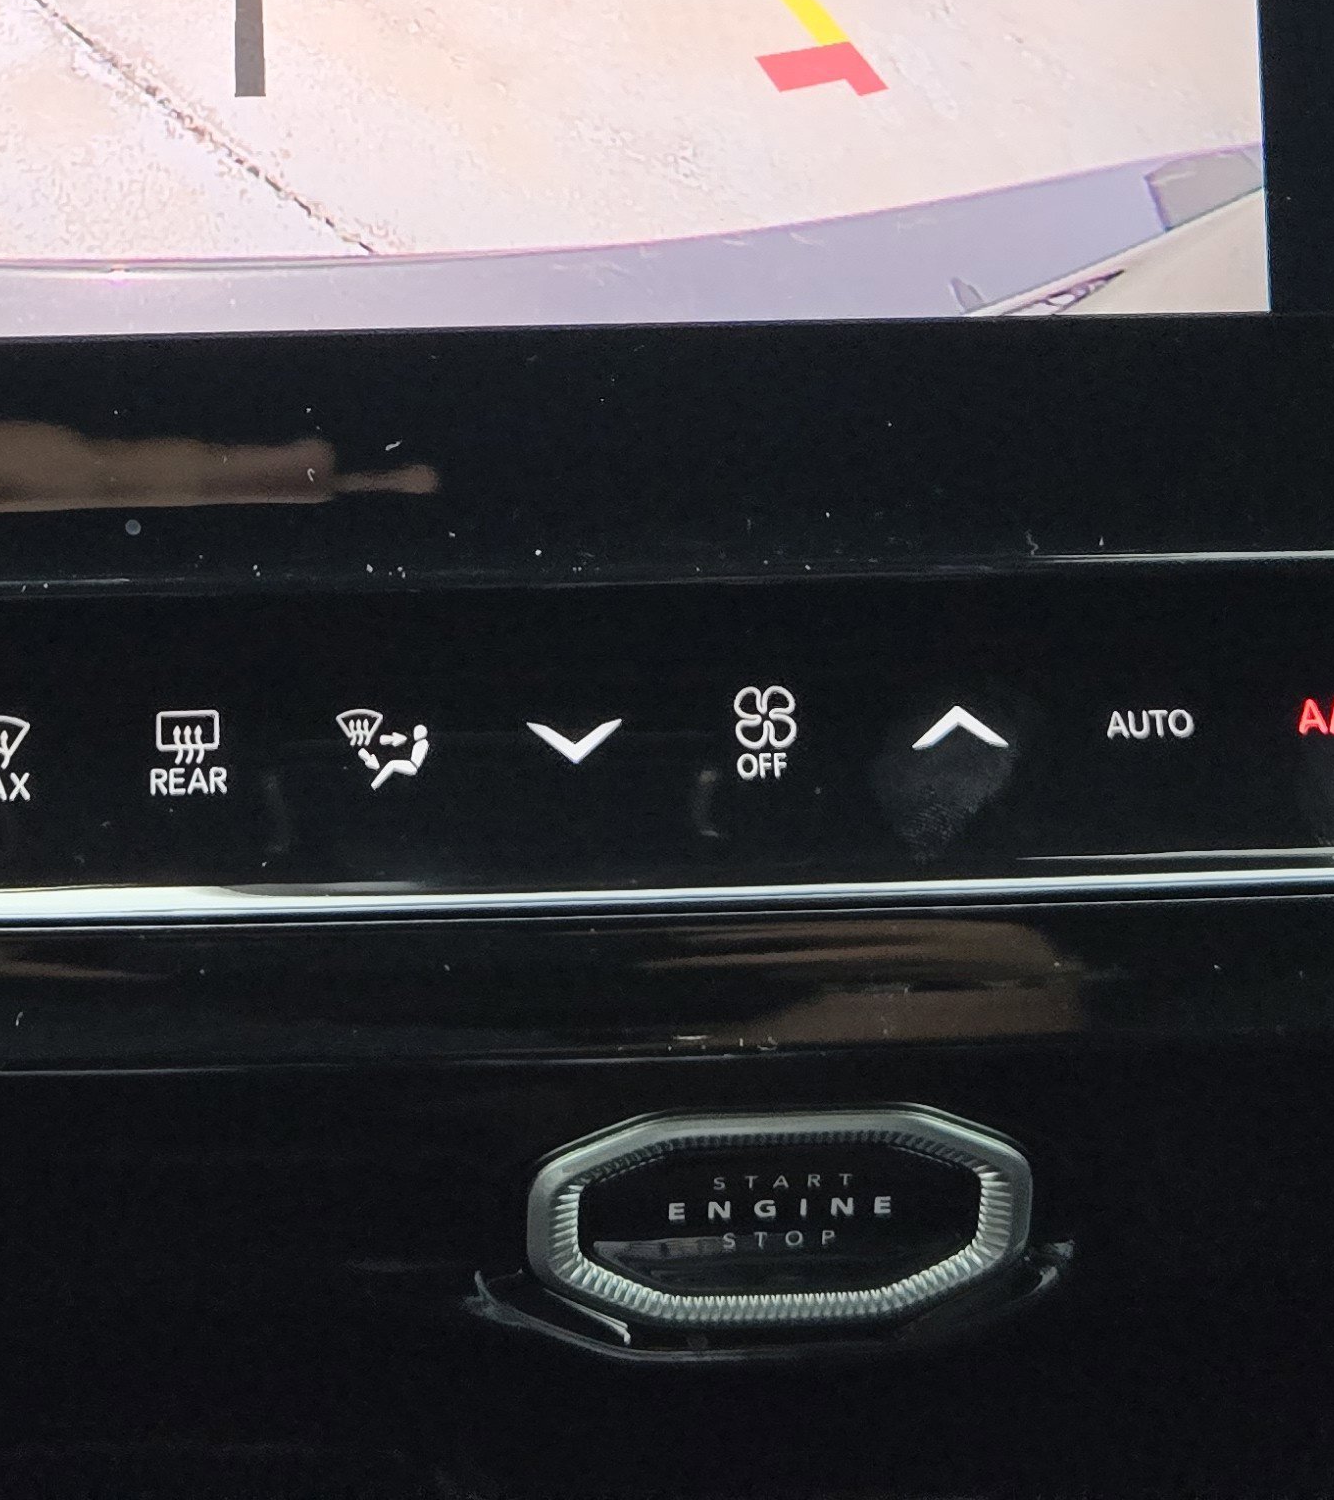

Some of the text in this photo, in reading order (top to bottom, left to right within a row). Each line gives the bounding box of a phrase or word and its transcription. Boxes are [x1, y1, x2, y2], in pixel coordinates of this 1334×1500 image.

[1105, 707, 1196, 740] AUTO
[735, 750, 788, 781] OFF
[148, 765, 229, 797] REAR
[712, 1172, 855, 1191] START
[668, 1195, 893, 1222] ENGINE
[722, 1229, 836, 1250] STOP
